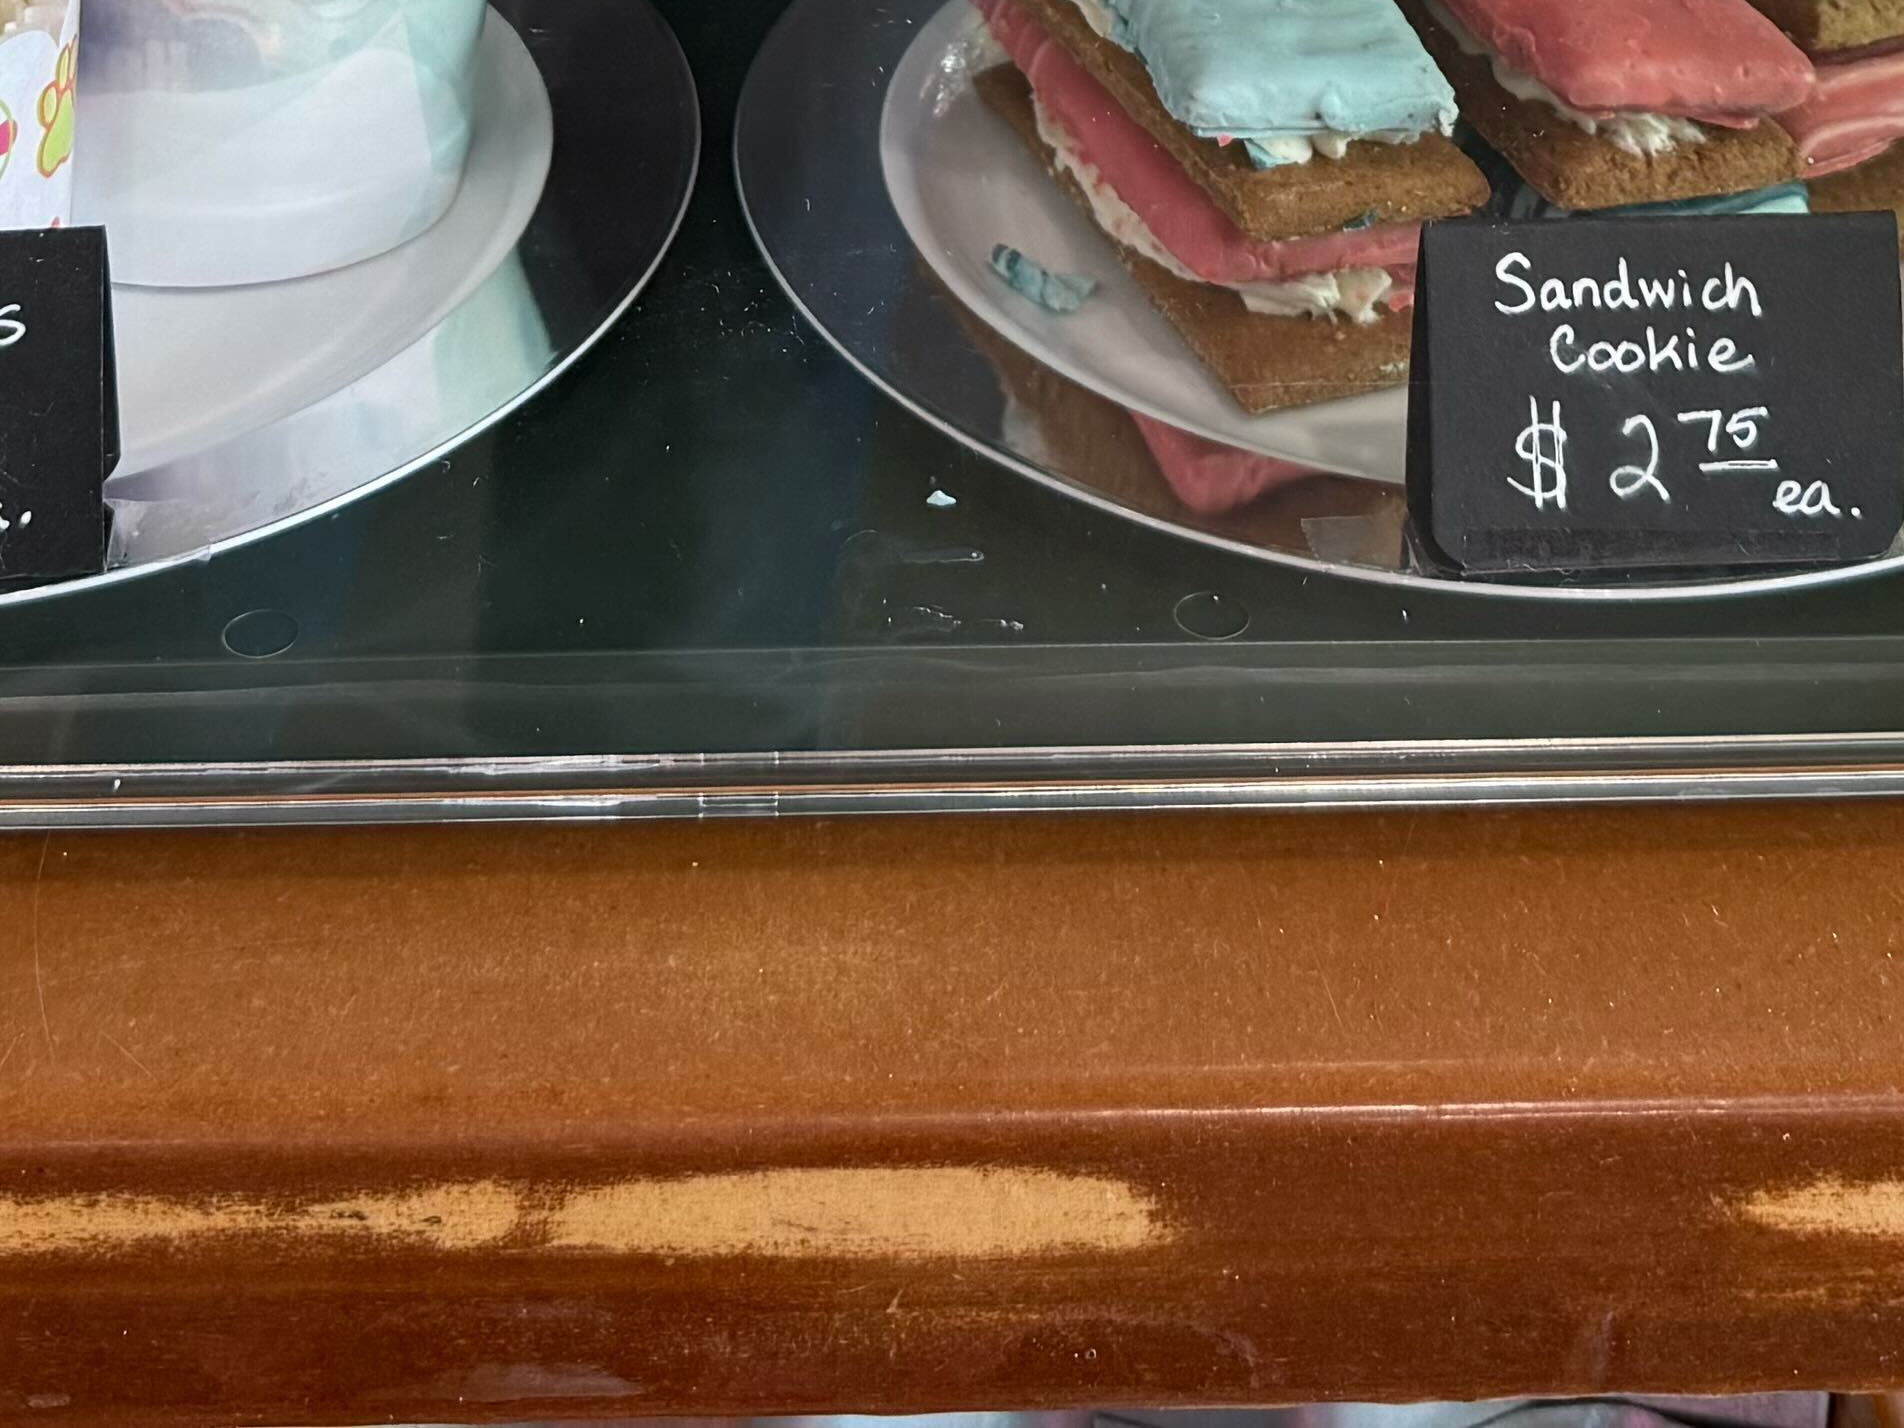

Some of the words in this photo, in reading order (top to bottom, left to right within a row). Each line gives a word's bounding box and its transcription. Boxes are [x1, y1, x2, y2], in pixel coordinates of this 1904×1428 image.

[1494, 250, 1764, 318] Sandwich
[1549, 324, 1757, 375] Cookie
[1771, 479, 1864, 521] ea.
